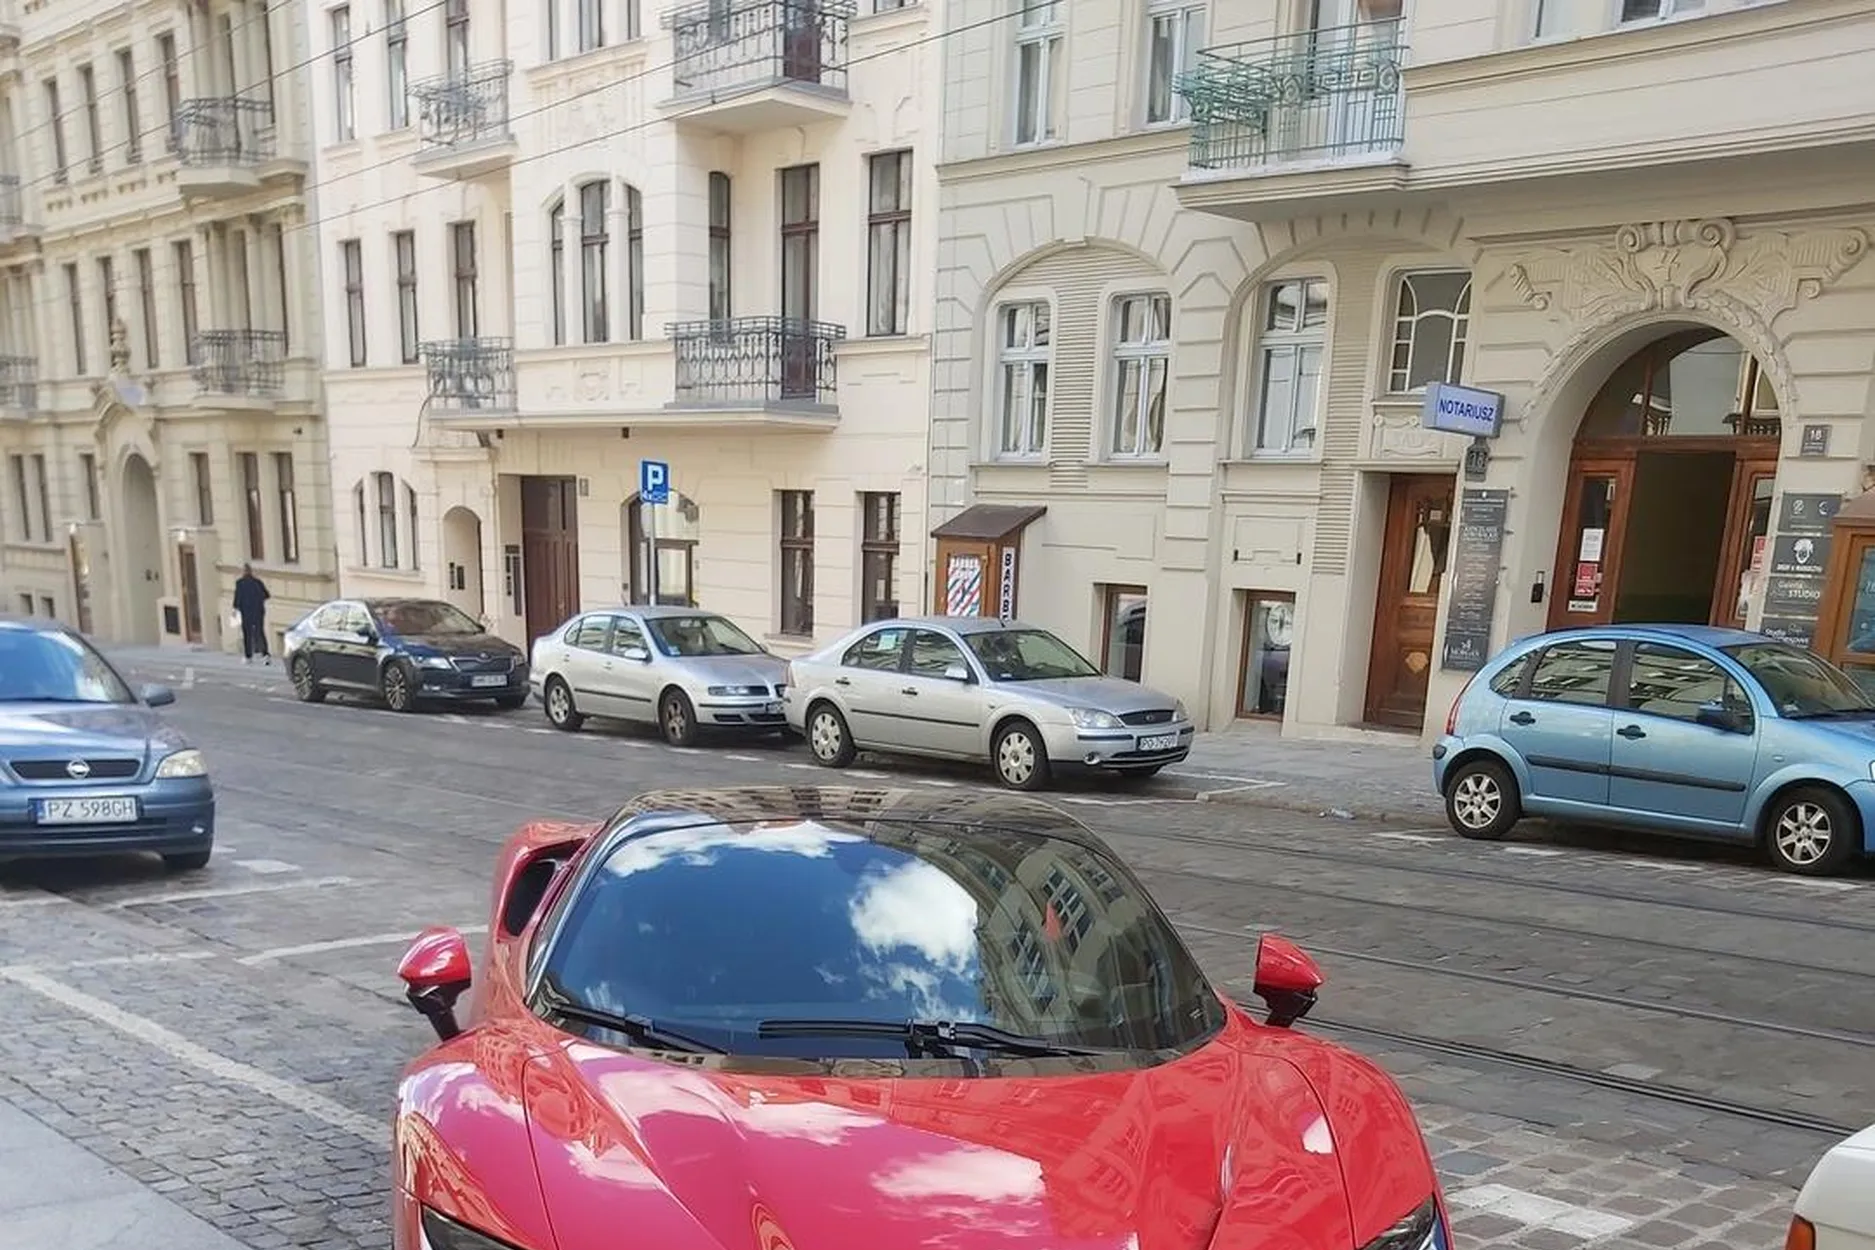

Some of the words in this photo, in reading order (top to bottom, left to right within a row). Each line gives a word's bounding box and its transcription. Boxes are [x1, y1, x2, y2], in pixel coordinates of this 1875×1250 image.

[1439, 399, 1494, 422] NOTARIUSZ
[647, 464, 664, 491] P
[1788, 589, 1821, 599] STUDIO
[48, 801, 73, 818] PZ
[80, 800, 134, 818] 598GH
